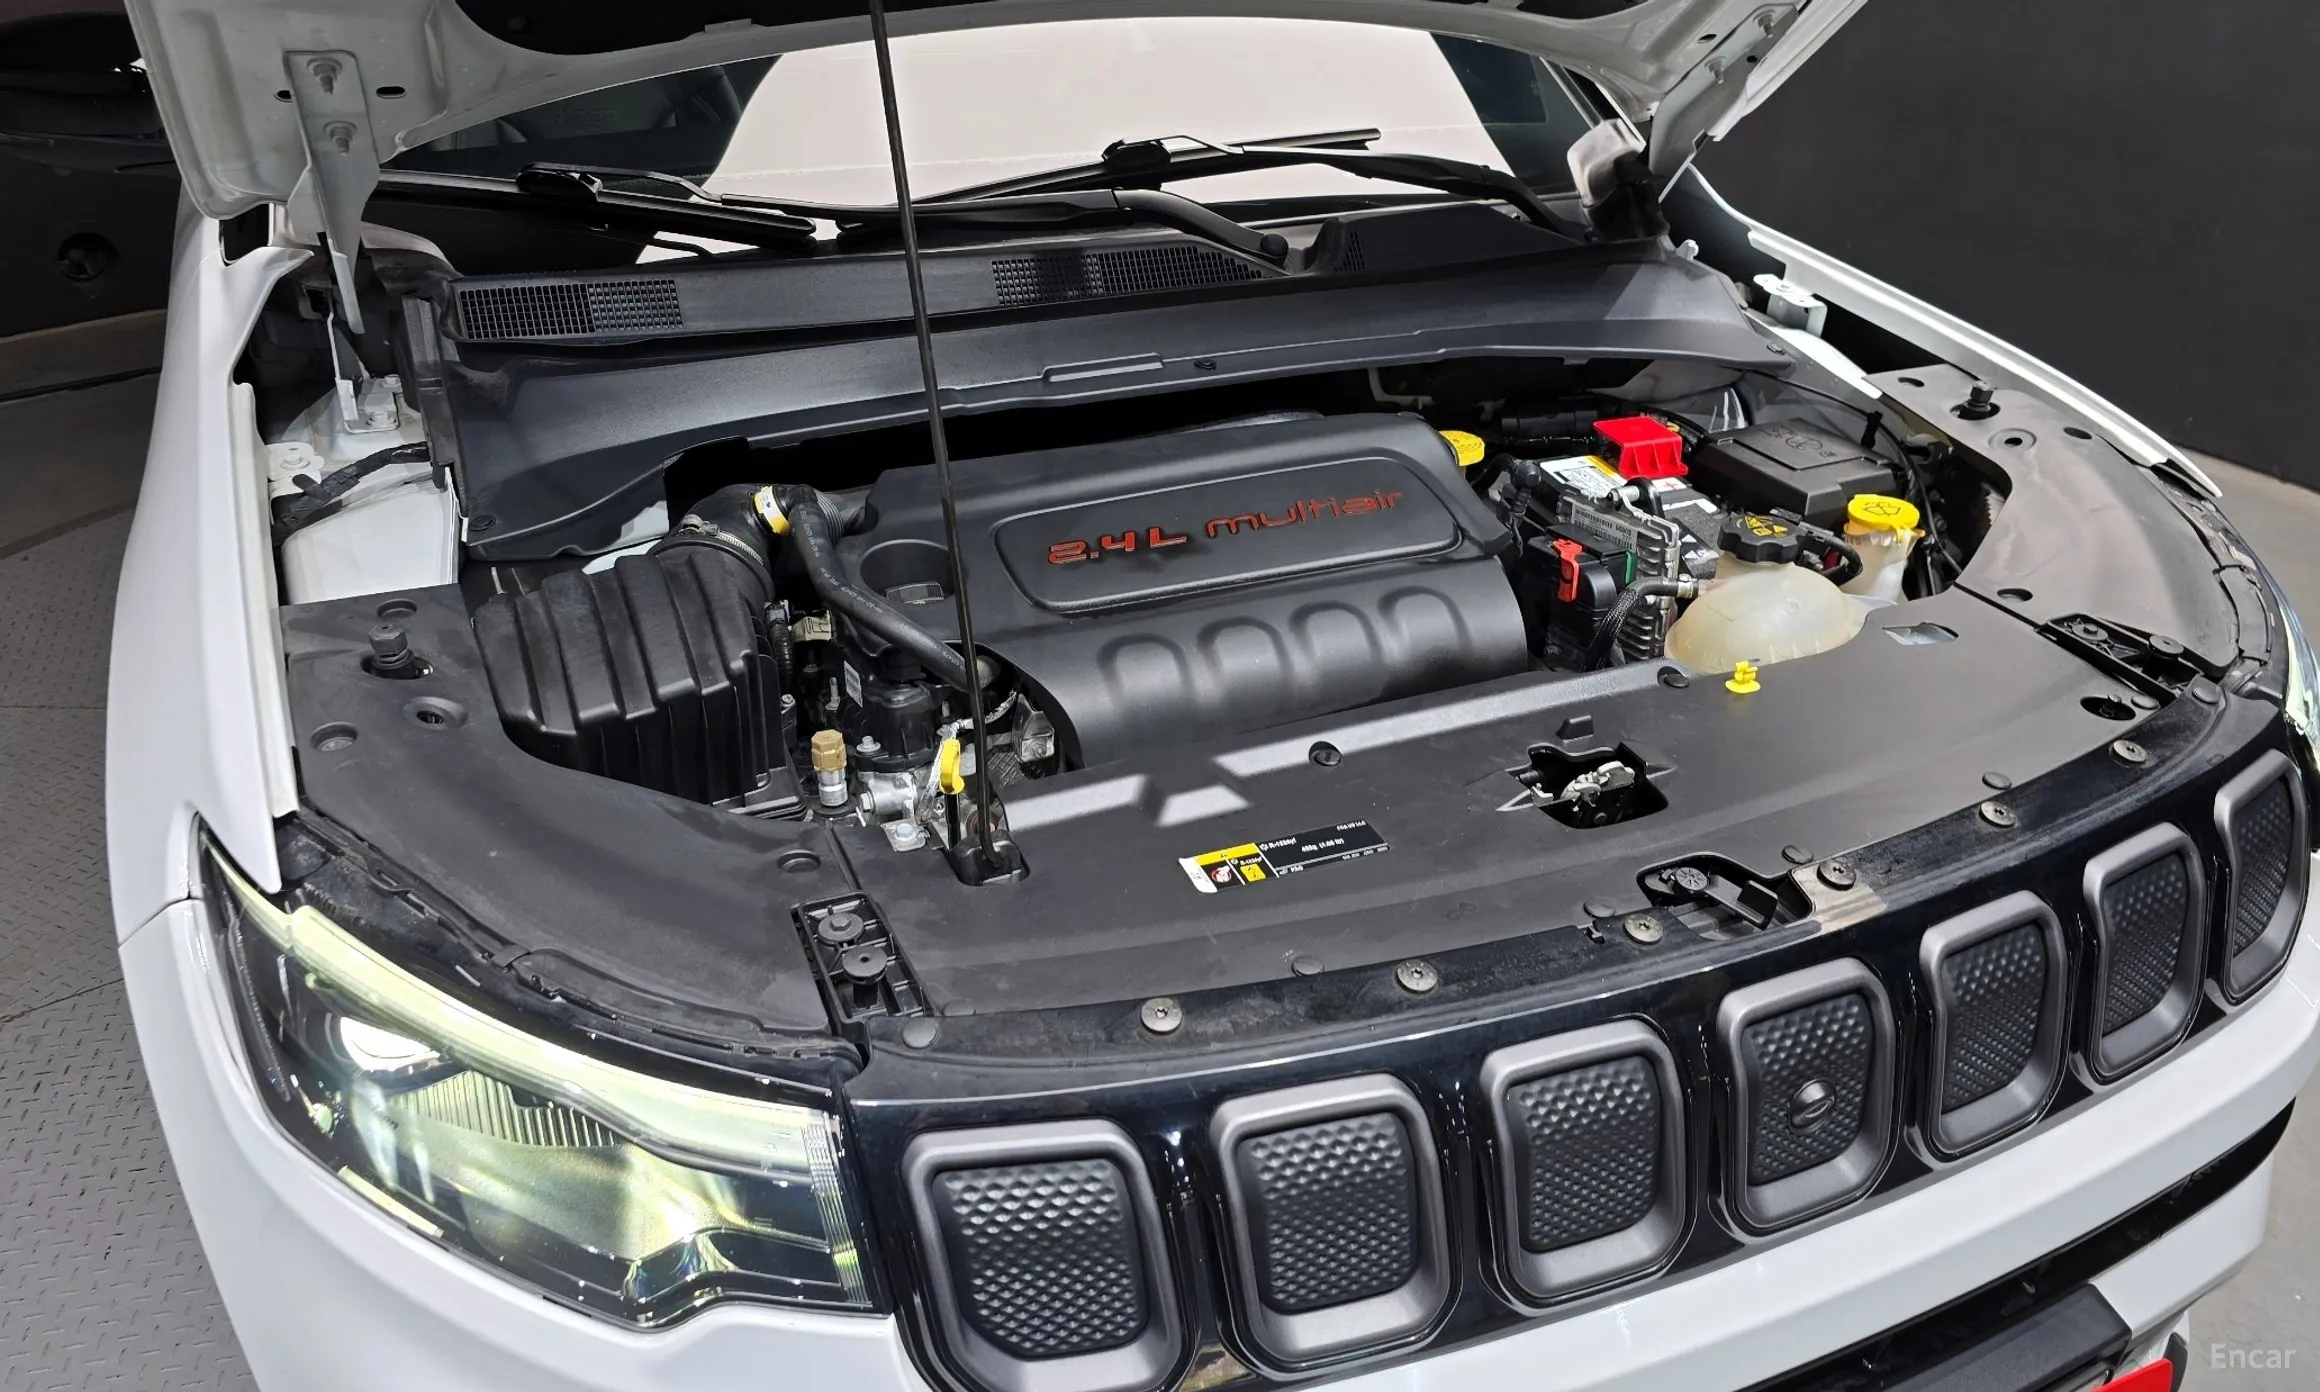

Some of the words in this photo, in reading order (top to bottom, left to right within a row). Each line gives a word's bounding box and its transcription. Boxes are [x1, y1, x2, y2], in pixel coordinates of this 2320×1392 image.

[1048, 531, 1136, 564] 2.4
[1149, 527, 1188, 549] L
[1206, 490, 1402, 537] multiair
